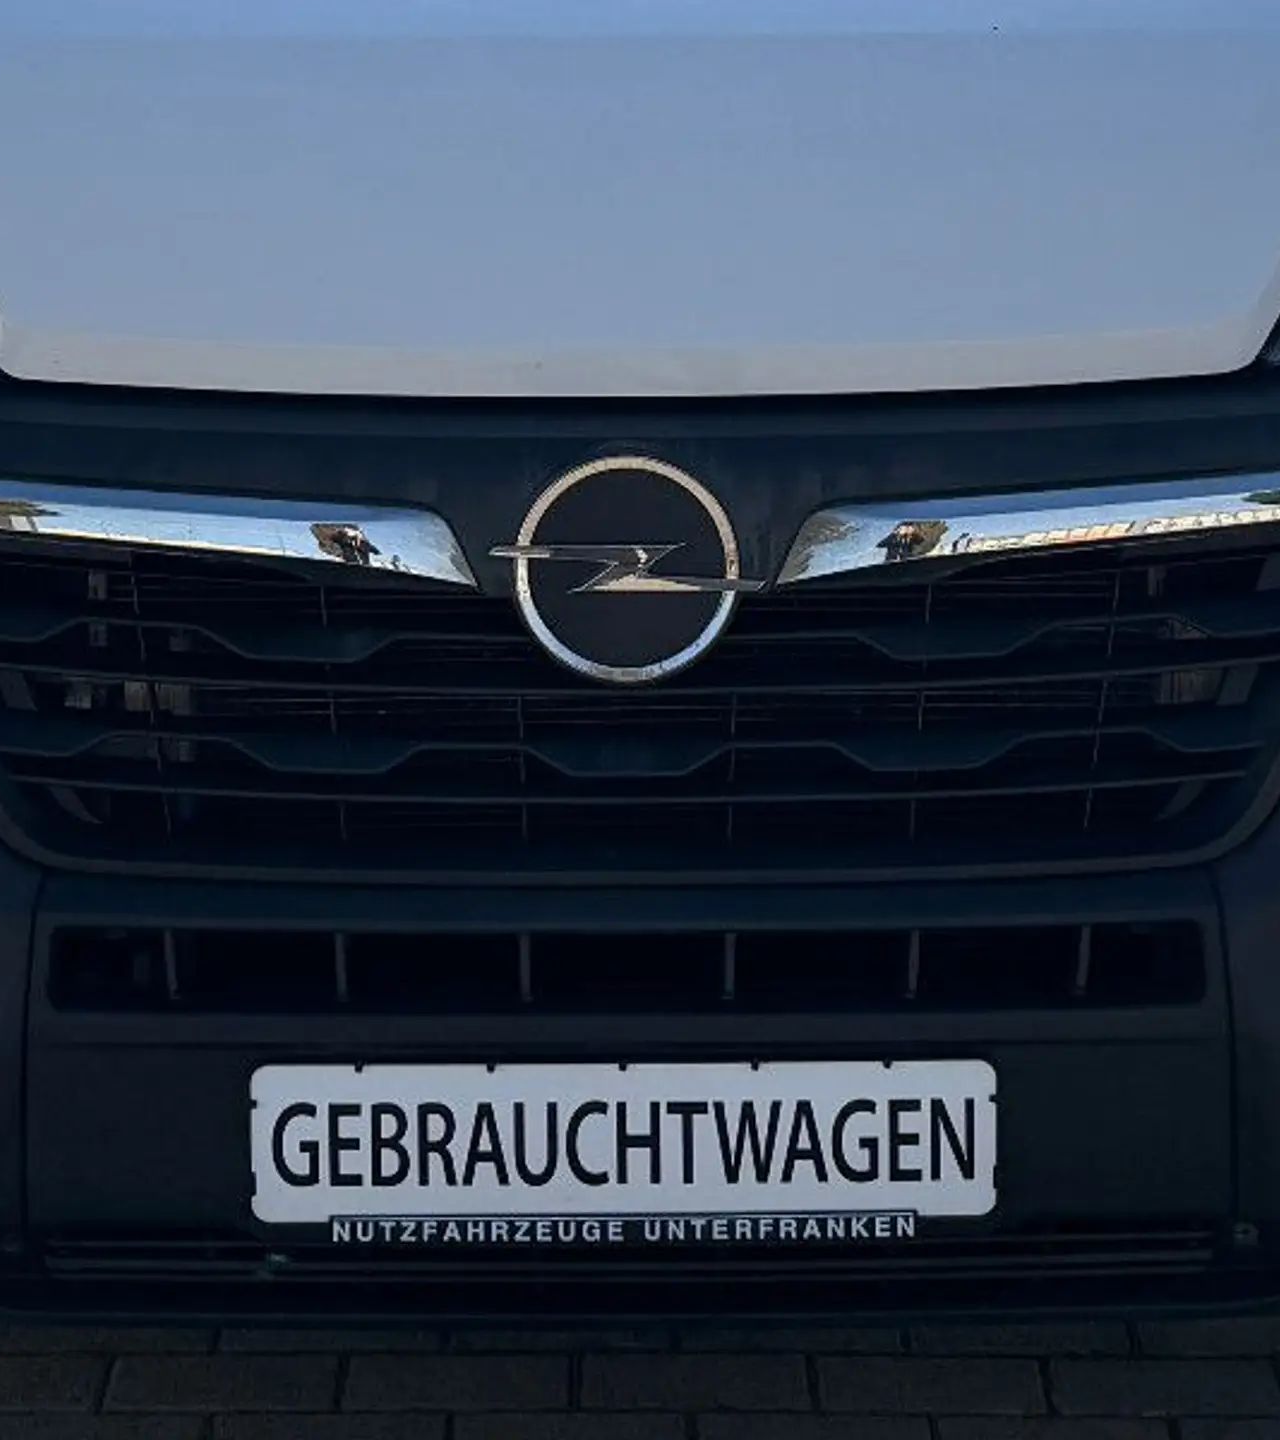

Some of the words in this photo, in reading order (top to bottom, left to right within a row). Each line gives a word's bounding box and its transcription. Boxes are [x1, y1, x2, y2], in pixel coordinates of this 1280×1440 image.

[272, 1098, 975, 1187] GEBRAUCHTWAGEN
[332, 1220, 624, 1242] NUTZFAHRZEUGE
[644, 1216, 915, 1241] UNTERFRANKEN
